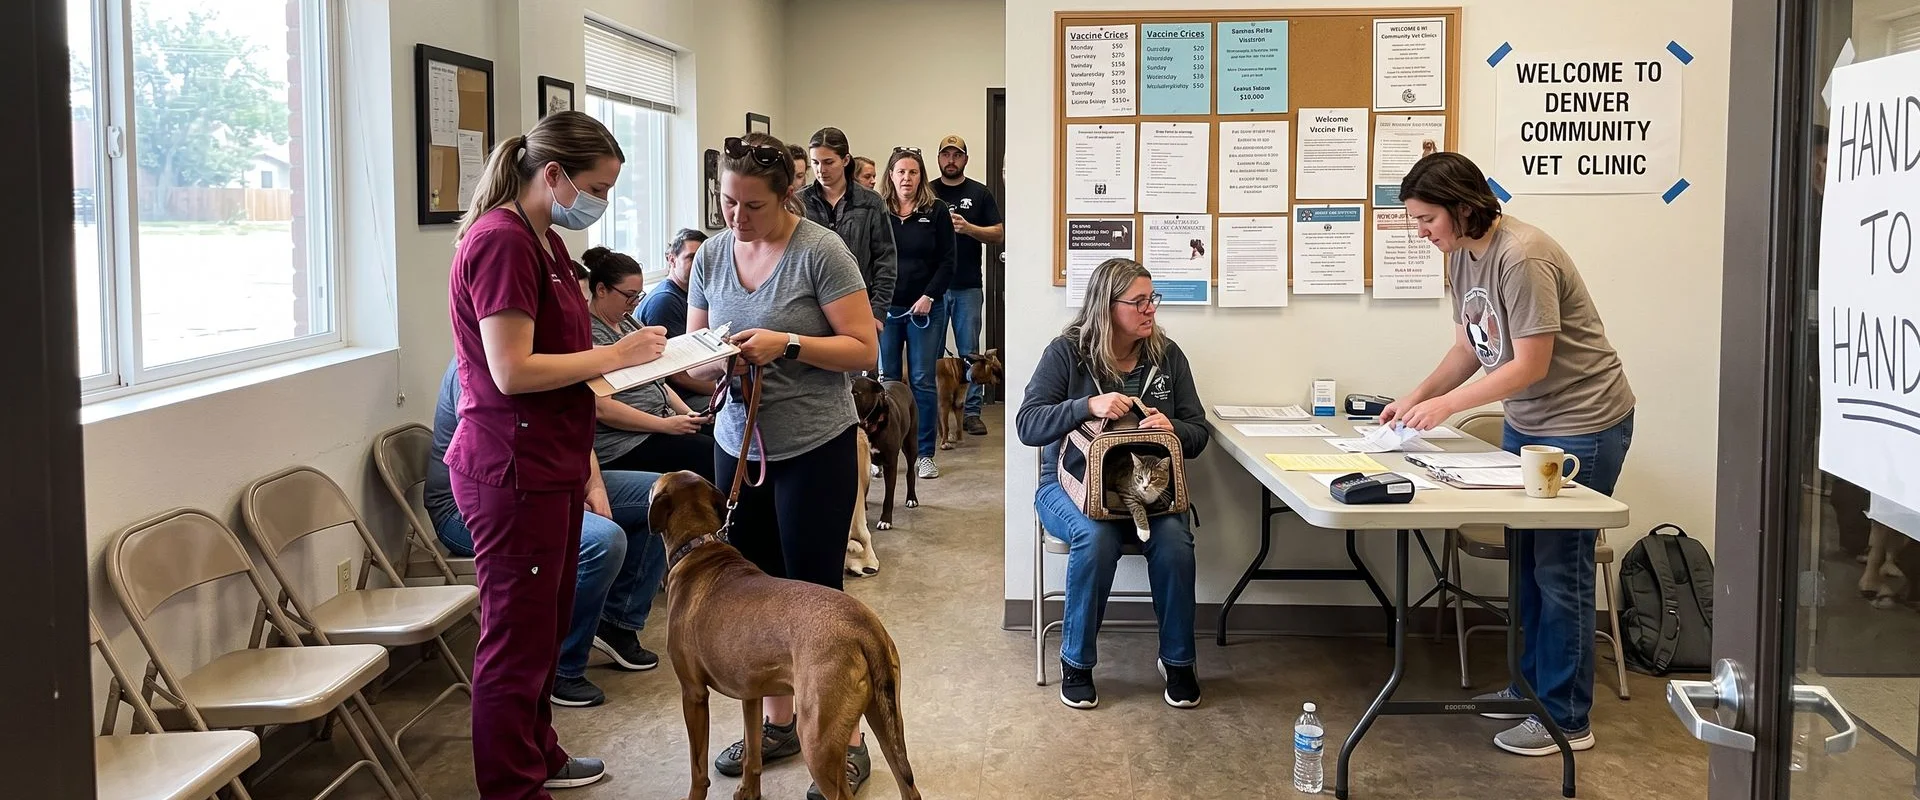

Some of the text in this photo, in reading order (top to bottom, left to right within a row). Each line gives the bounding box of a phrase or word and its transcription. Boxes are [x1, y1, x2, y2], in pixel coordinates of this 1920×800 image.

[1070, 31, 1129, 40] Vaccine Crices
[1180, 30, 1205, 38] Crices
[1516, 61, 1662, 83] WELCOME TO
[1545, 92, 1629, 113] DENVER
[1521, 121, 1651, 142] COMMUNITY
[1522, 154, 1647, 175] VET CLINIC
[1860, 209, 1911, 276] TO
[1833, 306, 1920, 394] HAND
